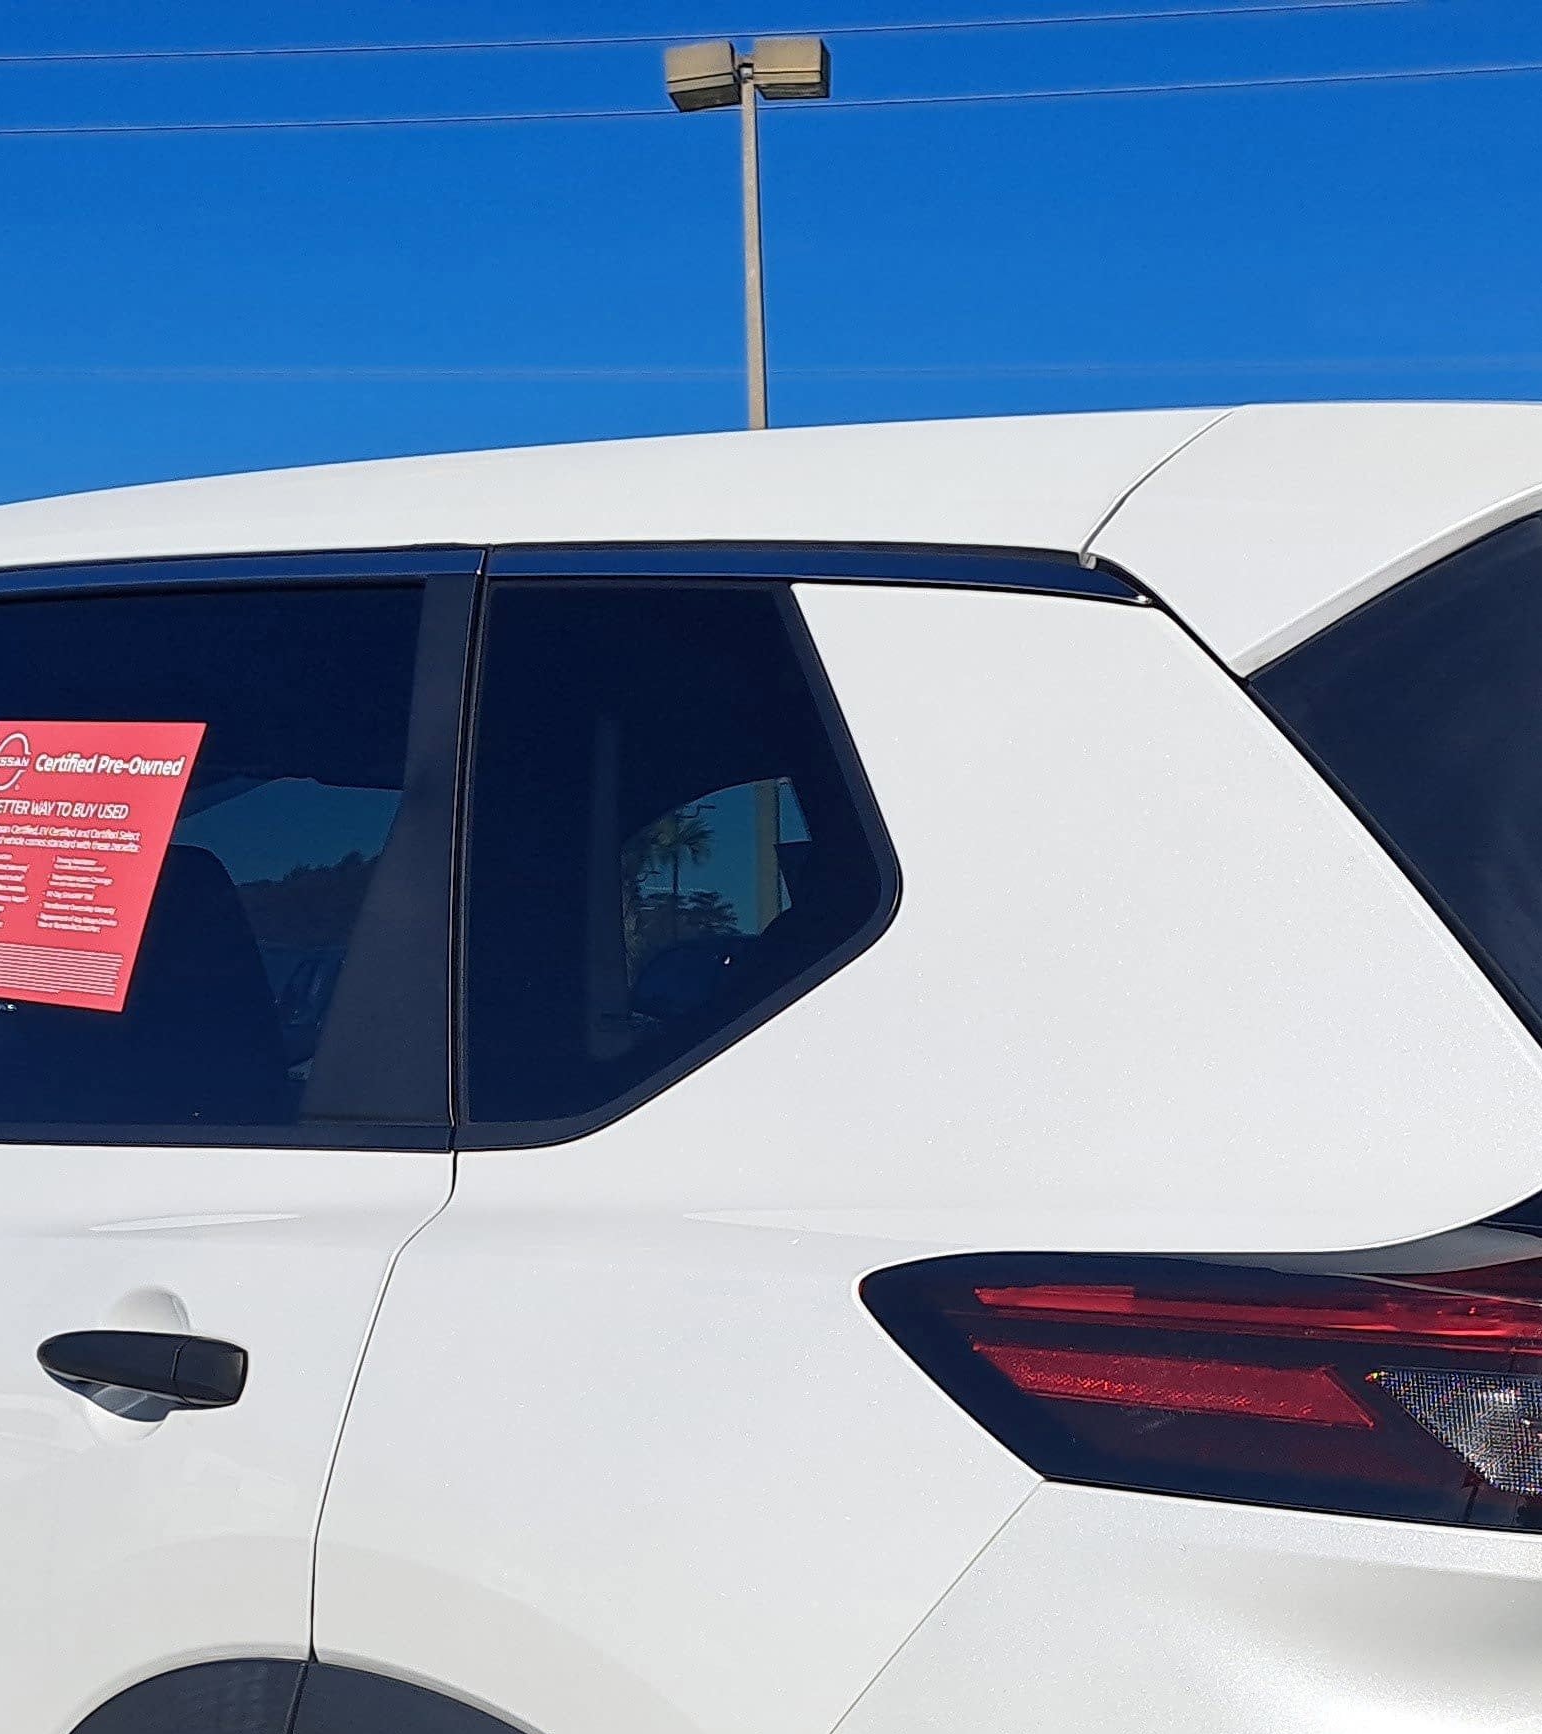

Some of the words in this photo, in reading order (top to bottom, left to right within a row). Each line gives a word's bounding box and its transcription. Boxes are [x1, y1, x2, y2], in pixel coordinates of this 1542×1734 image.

[35, 751, 94, 774] Certified
[97, 754, 187, 777] Pre-Owned
[30, 800, 56, 816] WAY
[56, 801, 72, 817] TO
[74, 802, 97, 818] BUY
[98, 803, 129, 820] USED
